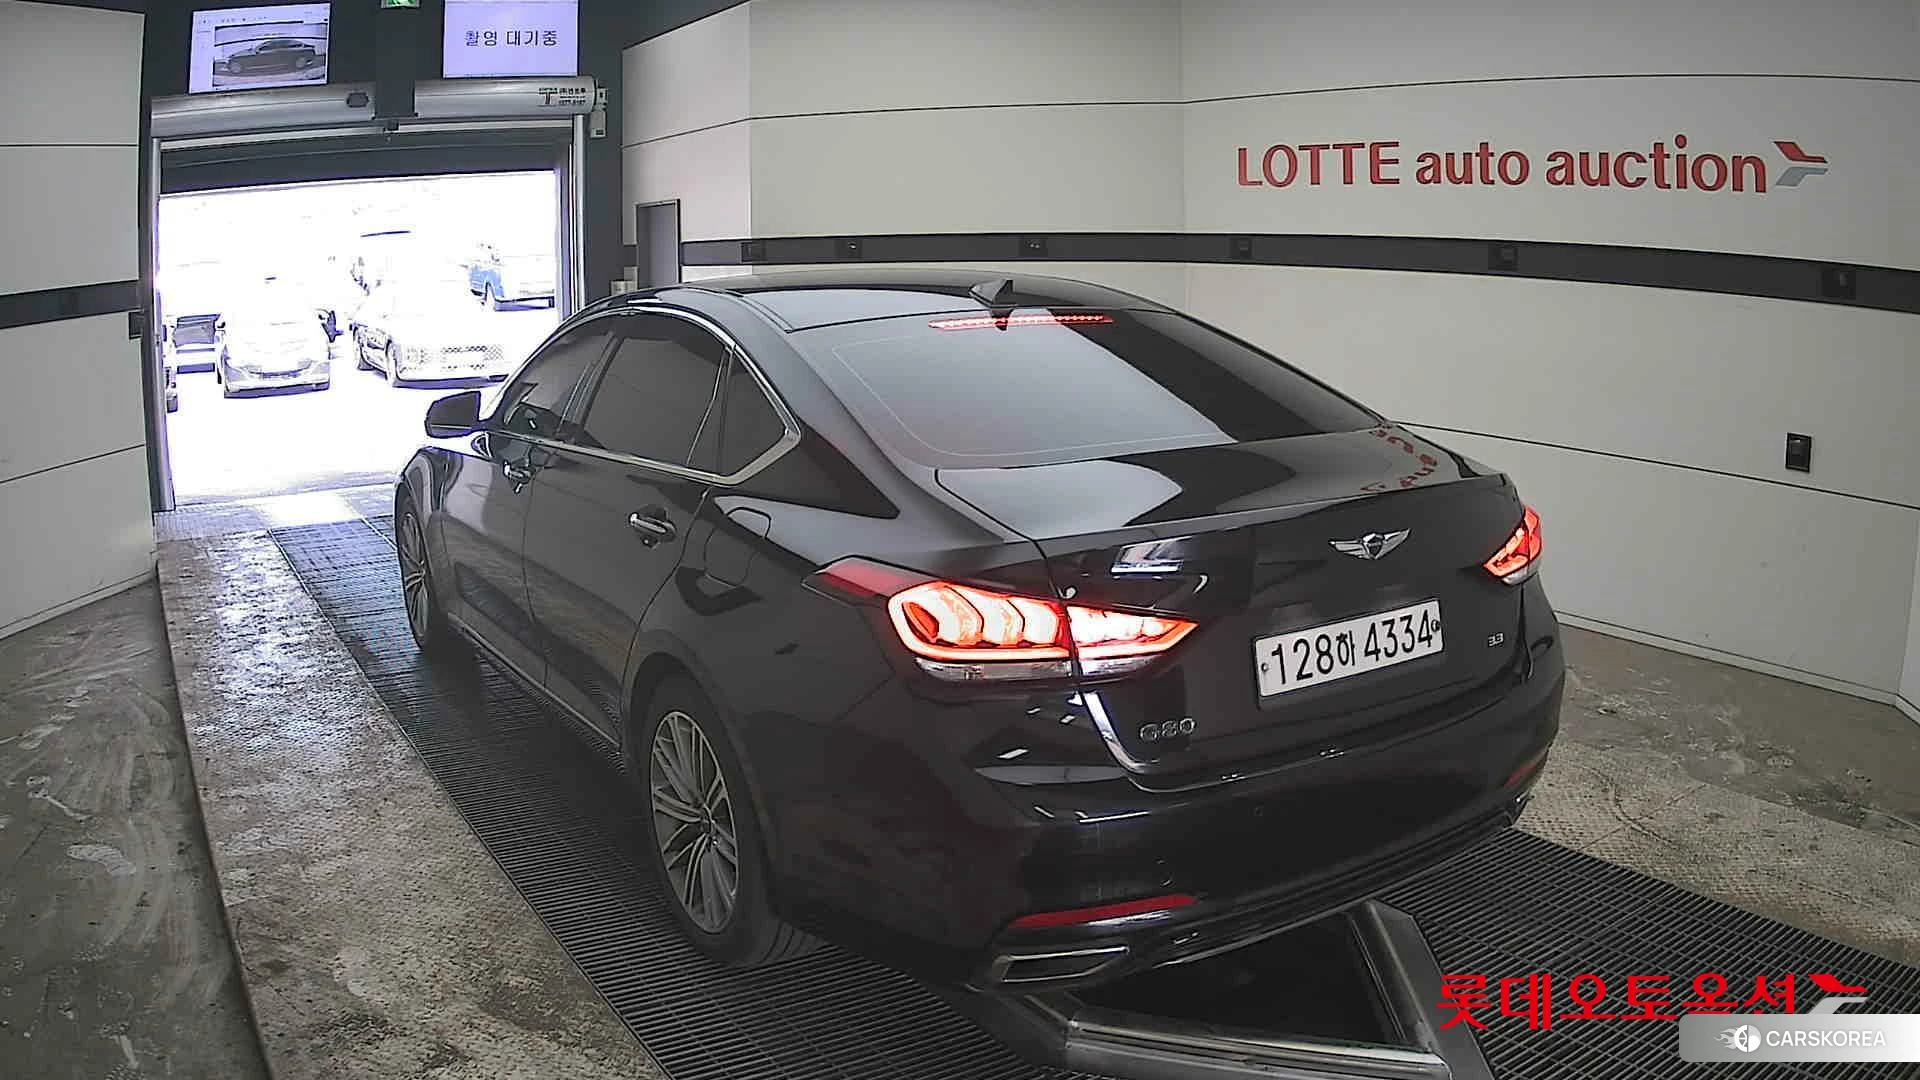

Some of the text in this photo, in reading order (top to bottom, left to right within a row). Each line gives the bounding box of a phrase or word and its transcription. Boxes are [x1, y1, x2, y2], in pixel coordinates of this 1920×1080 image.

[506, 30, 557, 47] 대기중
[1237, 134, 1767, 193] LOTTE auto auction
[1271, 609, 1433, 685] 128하 4334
[1140, 718, 1196, 741] G80
